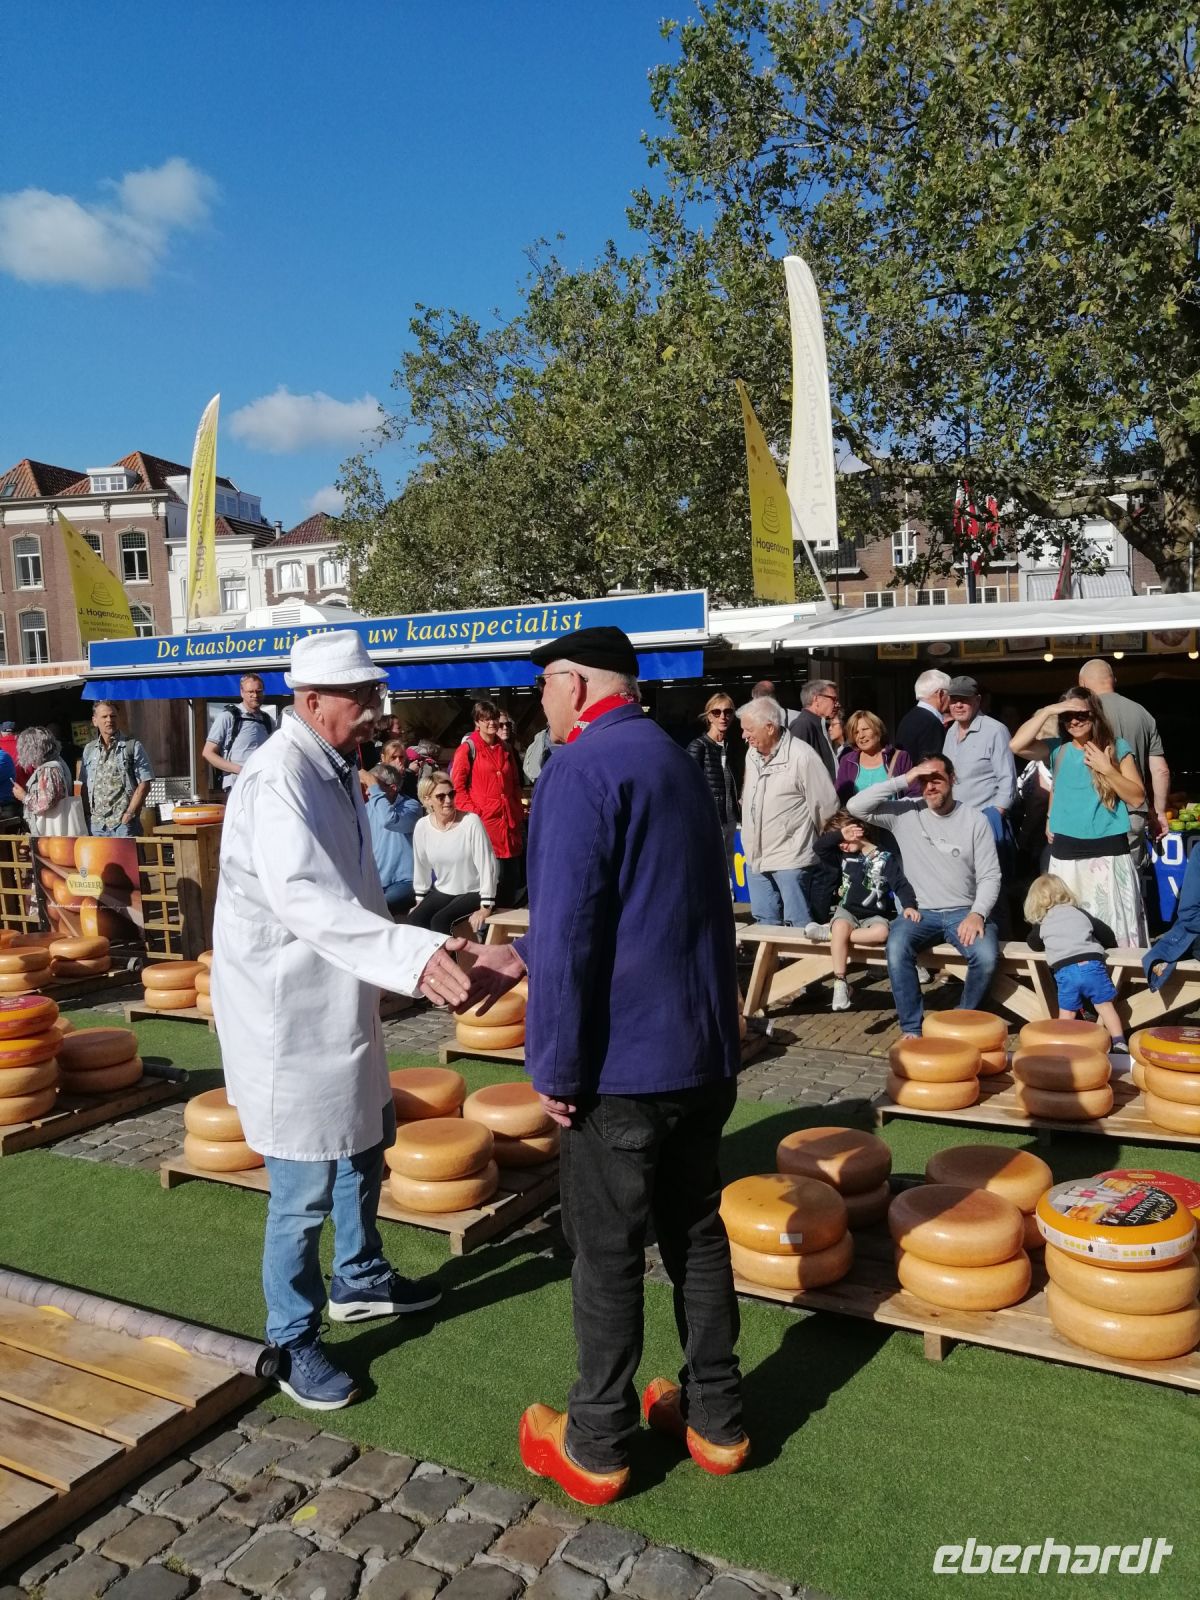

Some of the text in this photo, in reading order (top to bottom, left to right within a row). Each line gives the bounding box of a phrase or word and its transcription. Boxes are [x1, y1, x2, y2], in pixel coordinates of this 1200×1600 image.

[86, 608, 130, 620] Hogendoorn
[157, 640, 179, 658] De
[186, 635, 267, 656] kaasboer
[273, 631, 299, 649] uit
[368, 627, 398, 644] uw
[407, 610, 583, 643] kaasspecialist
